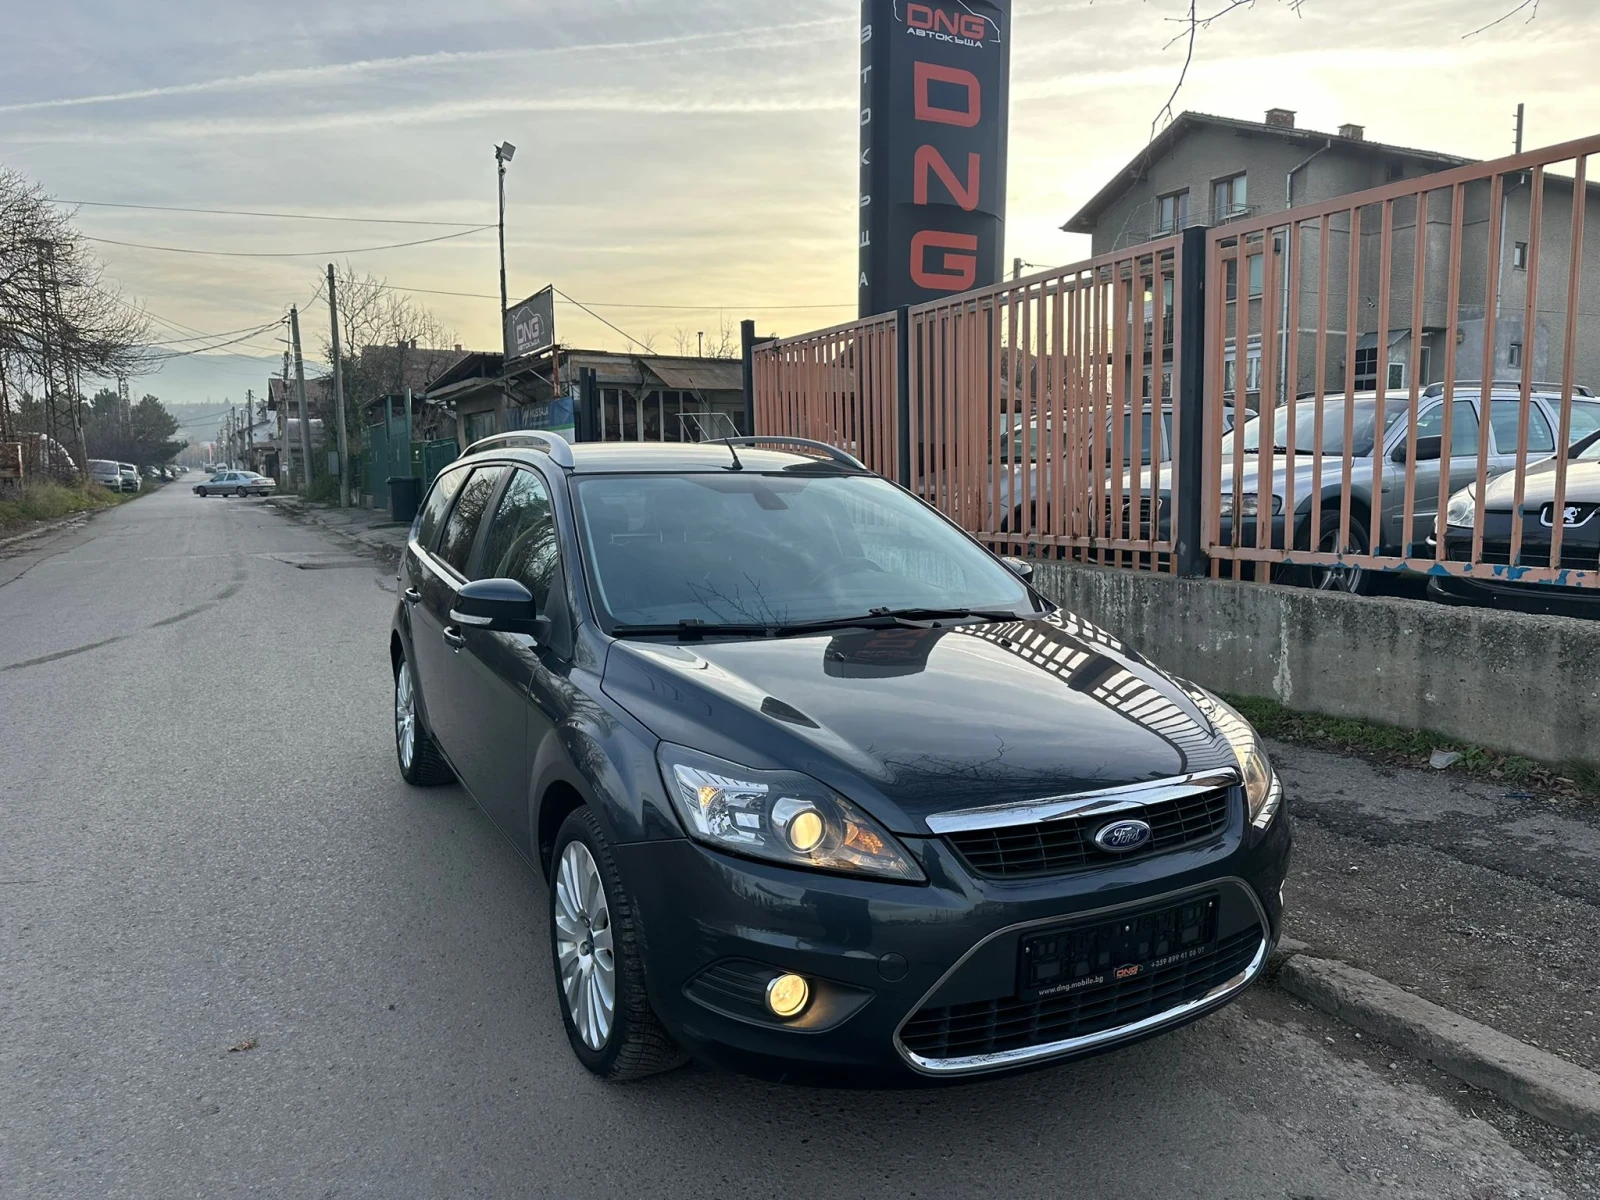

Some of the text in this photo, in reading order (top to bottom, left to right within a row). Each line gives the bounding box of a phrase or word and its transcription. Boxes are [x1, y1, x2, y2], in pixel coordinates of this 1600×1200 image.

[907, 3, 985, 40] DNG
[906, 27, 983, 48] АВТОКЪША
[910, 61, 981, 291] DNG
[516, 316, 540, 344] DNG
[1112, 826, 1141, 845] Ford
[1116, 966, 1139, 977] DNG
[1150, 958, 1167, 968] +359
[1038, 976, 1104, 995] www.dng.mobile.bg
